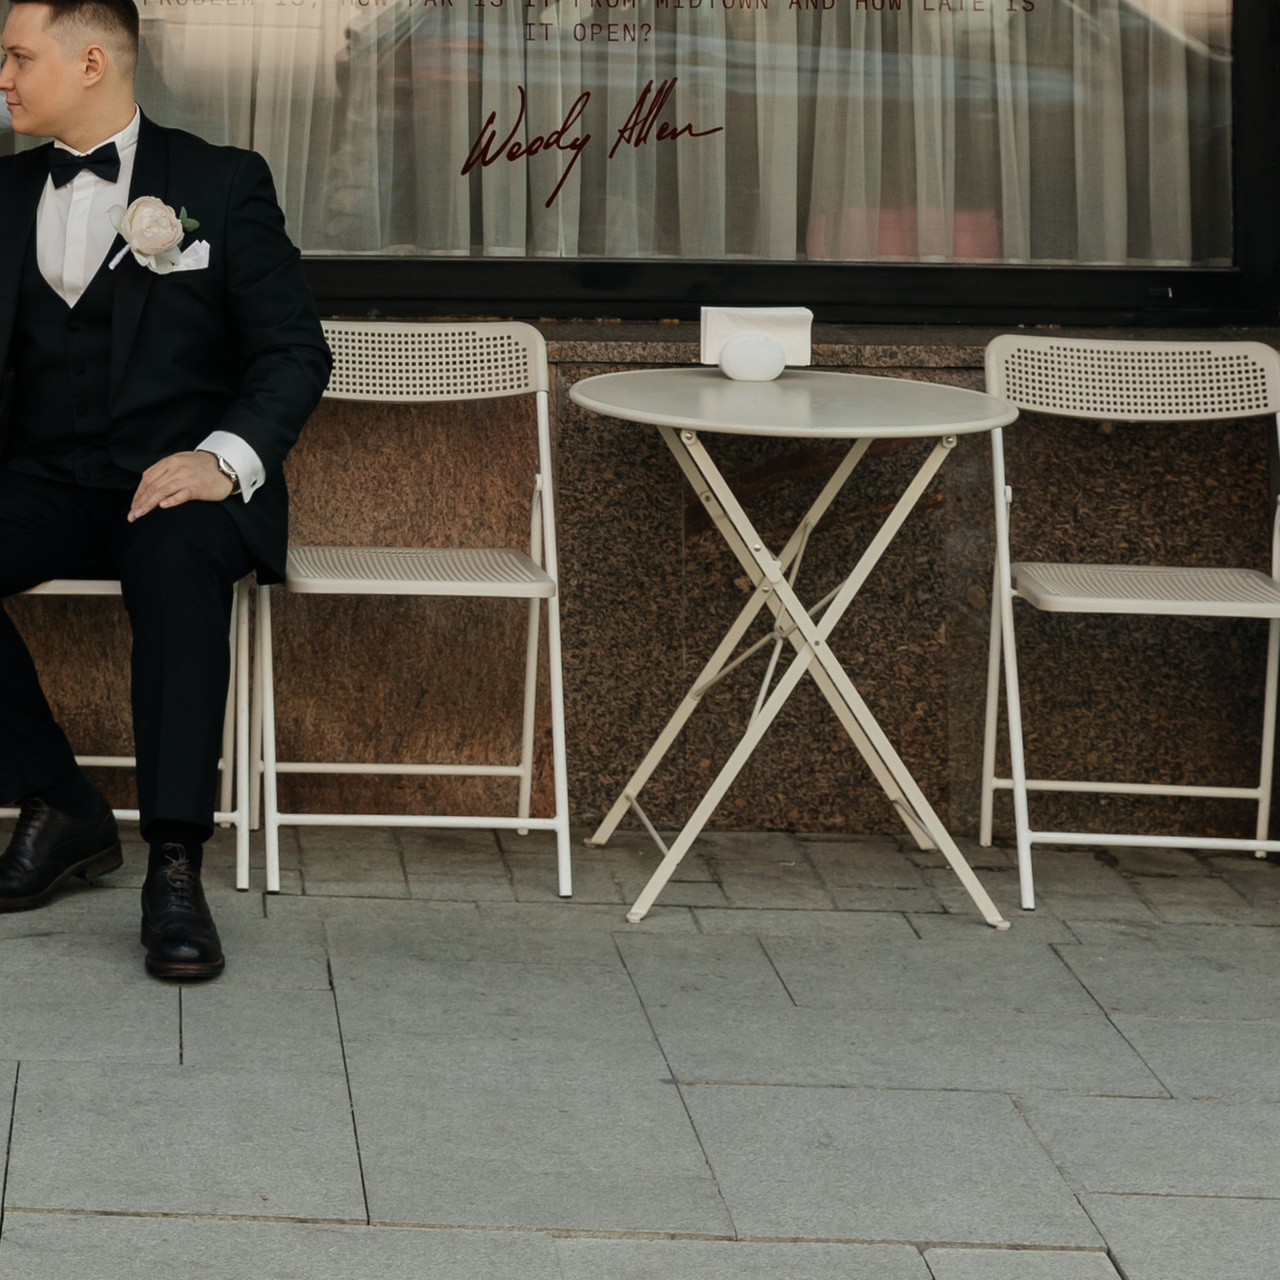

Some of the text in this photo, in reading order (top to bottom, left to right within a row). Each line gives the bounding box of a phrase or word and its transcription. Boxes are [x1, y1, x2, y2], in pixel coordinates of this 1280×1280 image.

[525, 23, 652, 42] IT OPEN?
[461, 77, 724, 208] Woody Allen
